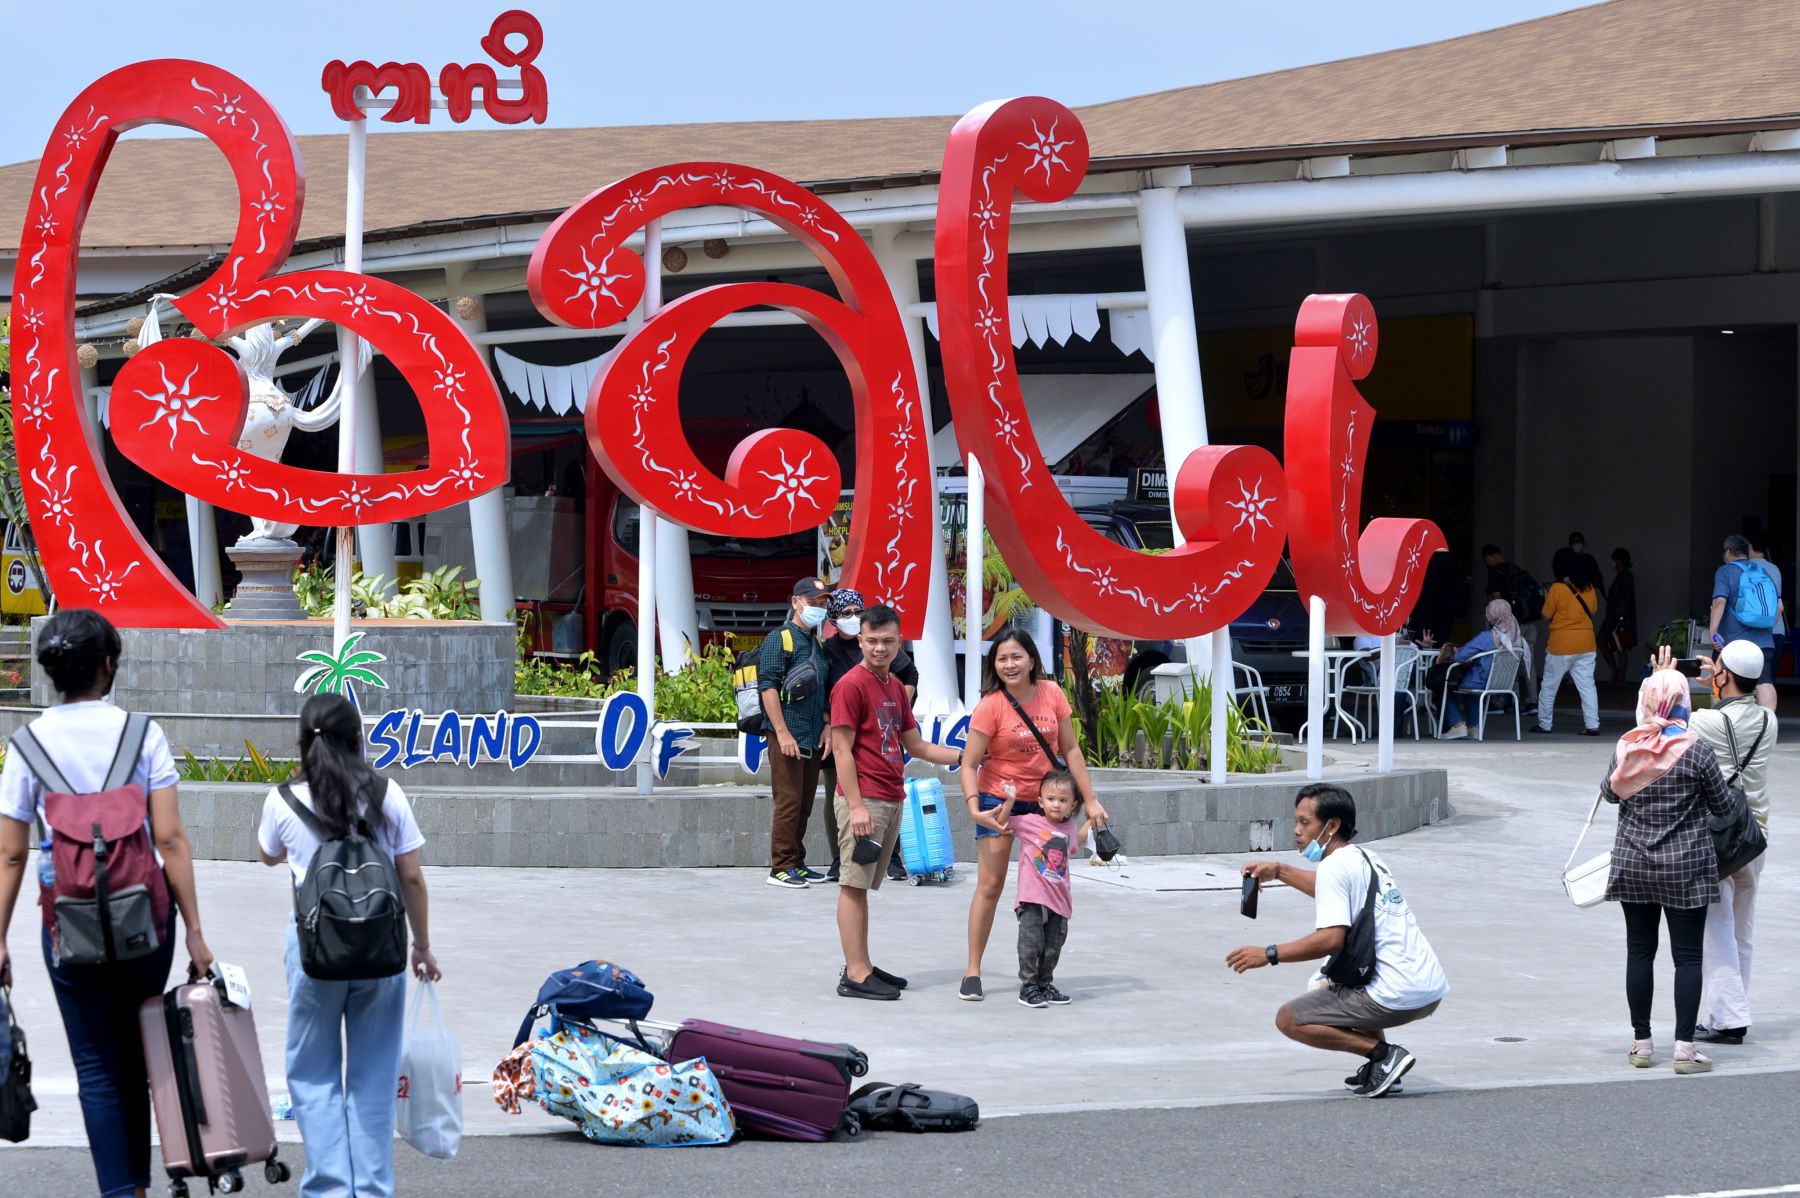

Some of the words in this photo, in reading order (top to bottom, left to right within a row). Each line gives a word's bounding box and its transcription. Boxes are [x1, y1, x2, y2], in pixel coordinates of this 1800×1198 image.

[1416, 423, 1446, 434] Toilets
[1142, 473, 1168, 487] DIM
[1148, 491, 1169, 499] DIMS
[829, 527, 850, 536] HOTPL
[346, 684, 542, 771] SLAND
